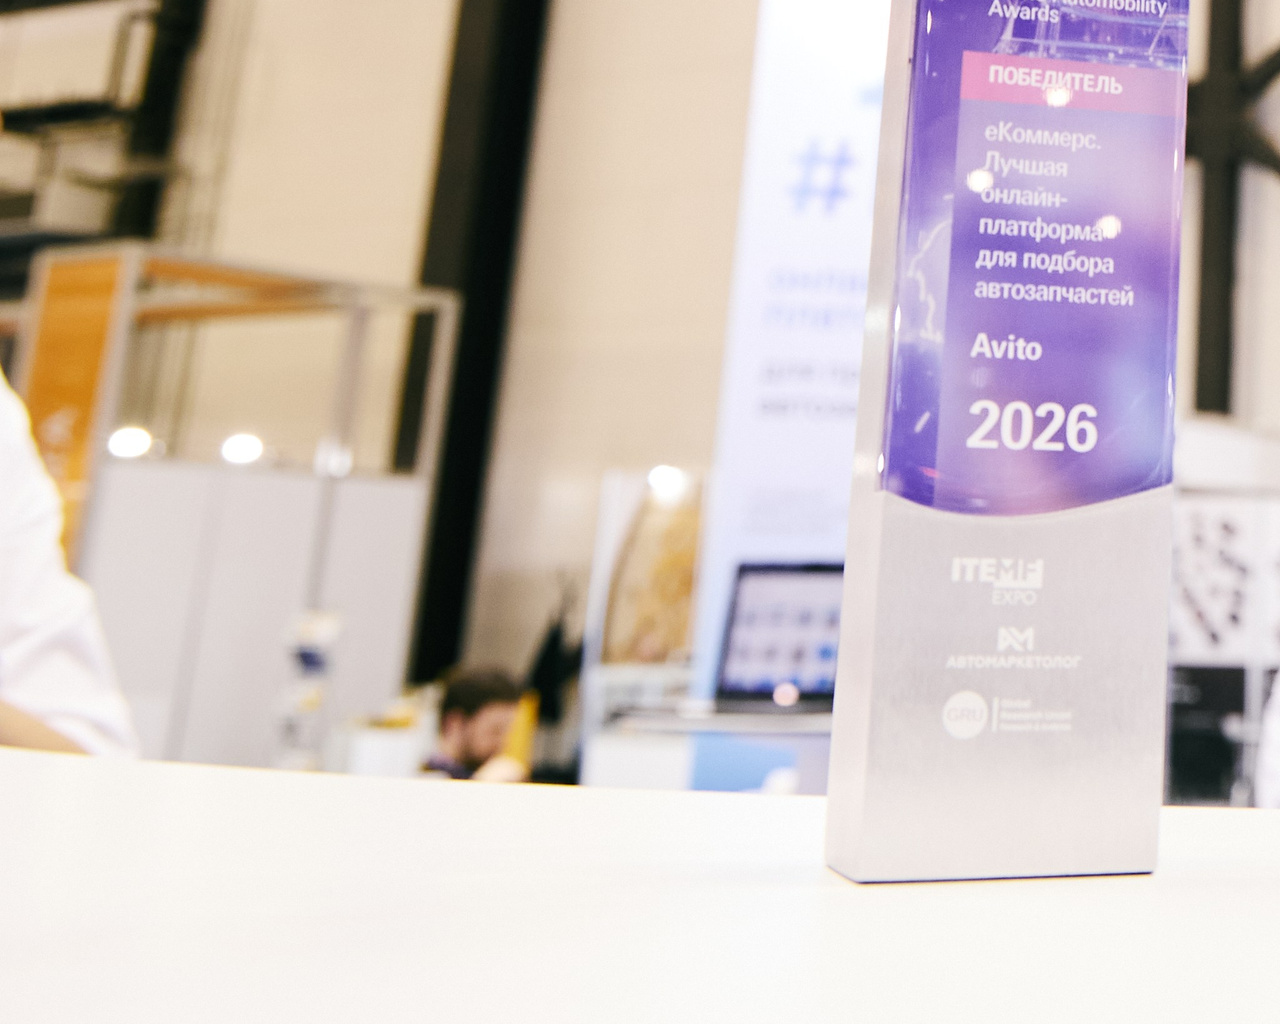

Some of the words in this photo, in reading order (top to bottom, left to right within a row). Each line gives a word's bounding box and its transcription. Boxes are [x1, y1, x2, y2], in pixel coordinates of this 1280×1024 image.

[988, 64, 1123, 95] ПОБЕДИТЕЛЬ
[983, 150, 1069, 178] Лучшая
[981, 187, 1068, 208] онлайн-
[978, 216, 1104, 244] платформа
[975, 249, 1018, 270] для
[1022, 249, 1115, 278] подбора
[974, 280, 1135, 307] автозапчастей
[970, 332, 1043, 362] Avito
[965, 399, 1099, 453] 2026
[992, 589, 1037, 606] EXPO
[945, 654, 1083, 670] АВТОМАРКЕТОЛОГ
